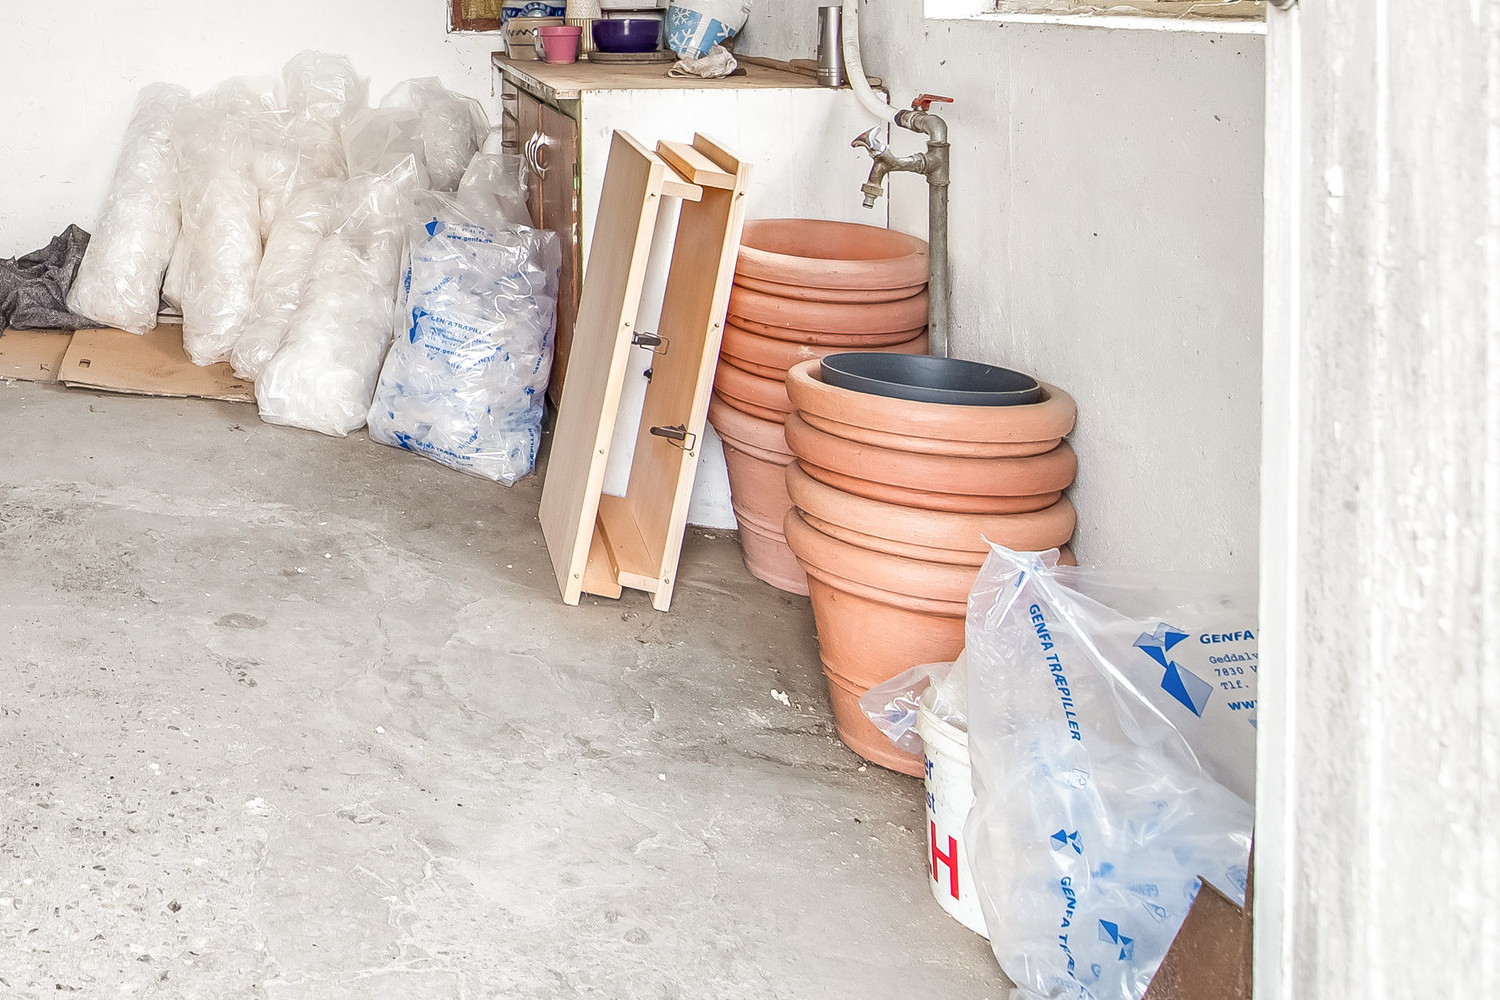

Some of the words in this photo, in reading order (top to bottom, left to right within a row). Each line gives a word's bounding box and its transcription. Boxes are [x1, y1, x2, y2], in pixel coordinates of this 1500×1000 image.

[1199, 629, 1256, 645] GENFA
[1029, 603, 1054, 651] GENFA
[1046, 653, 1081, 742] TRÆPILLER
[1213, 666, 1245, 678] 7830
[1220, 680, 1250, 691] Tlf.
[1227, 700, 1258, 711] ww
[1060, 875, 1077, 929] GENFA
